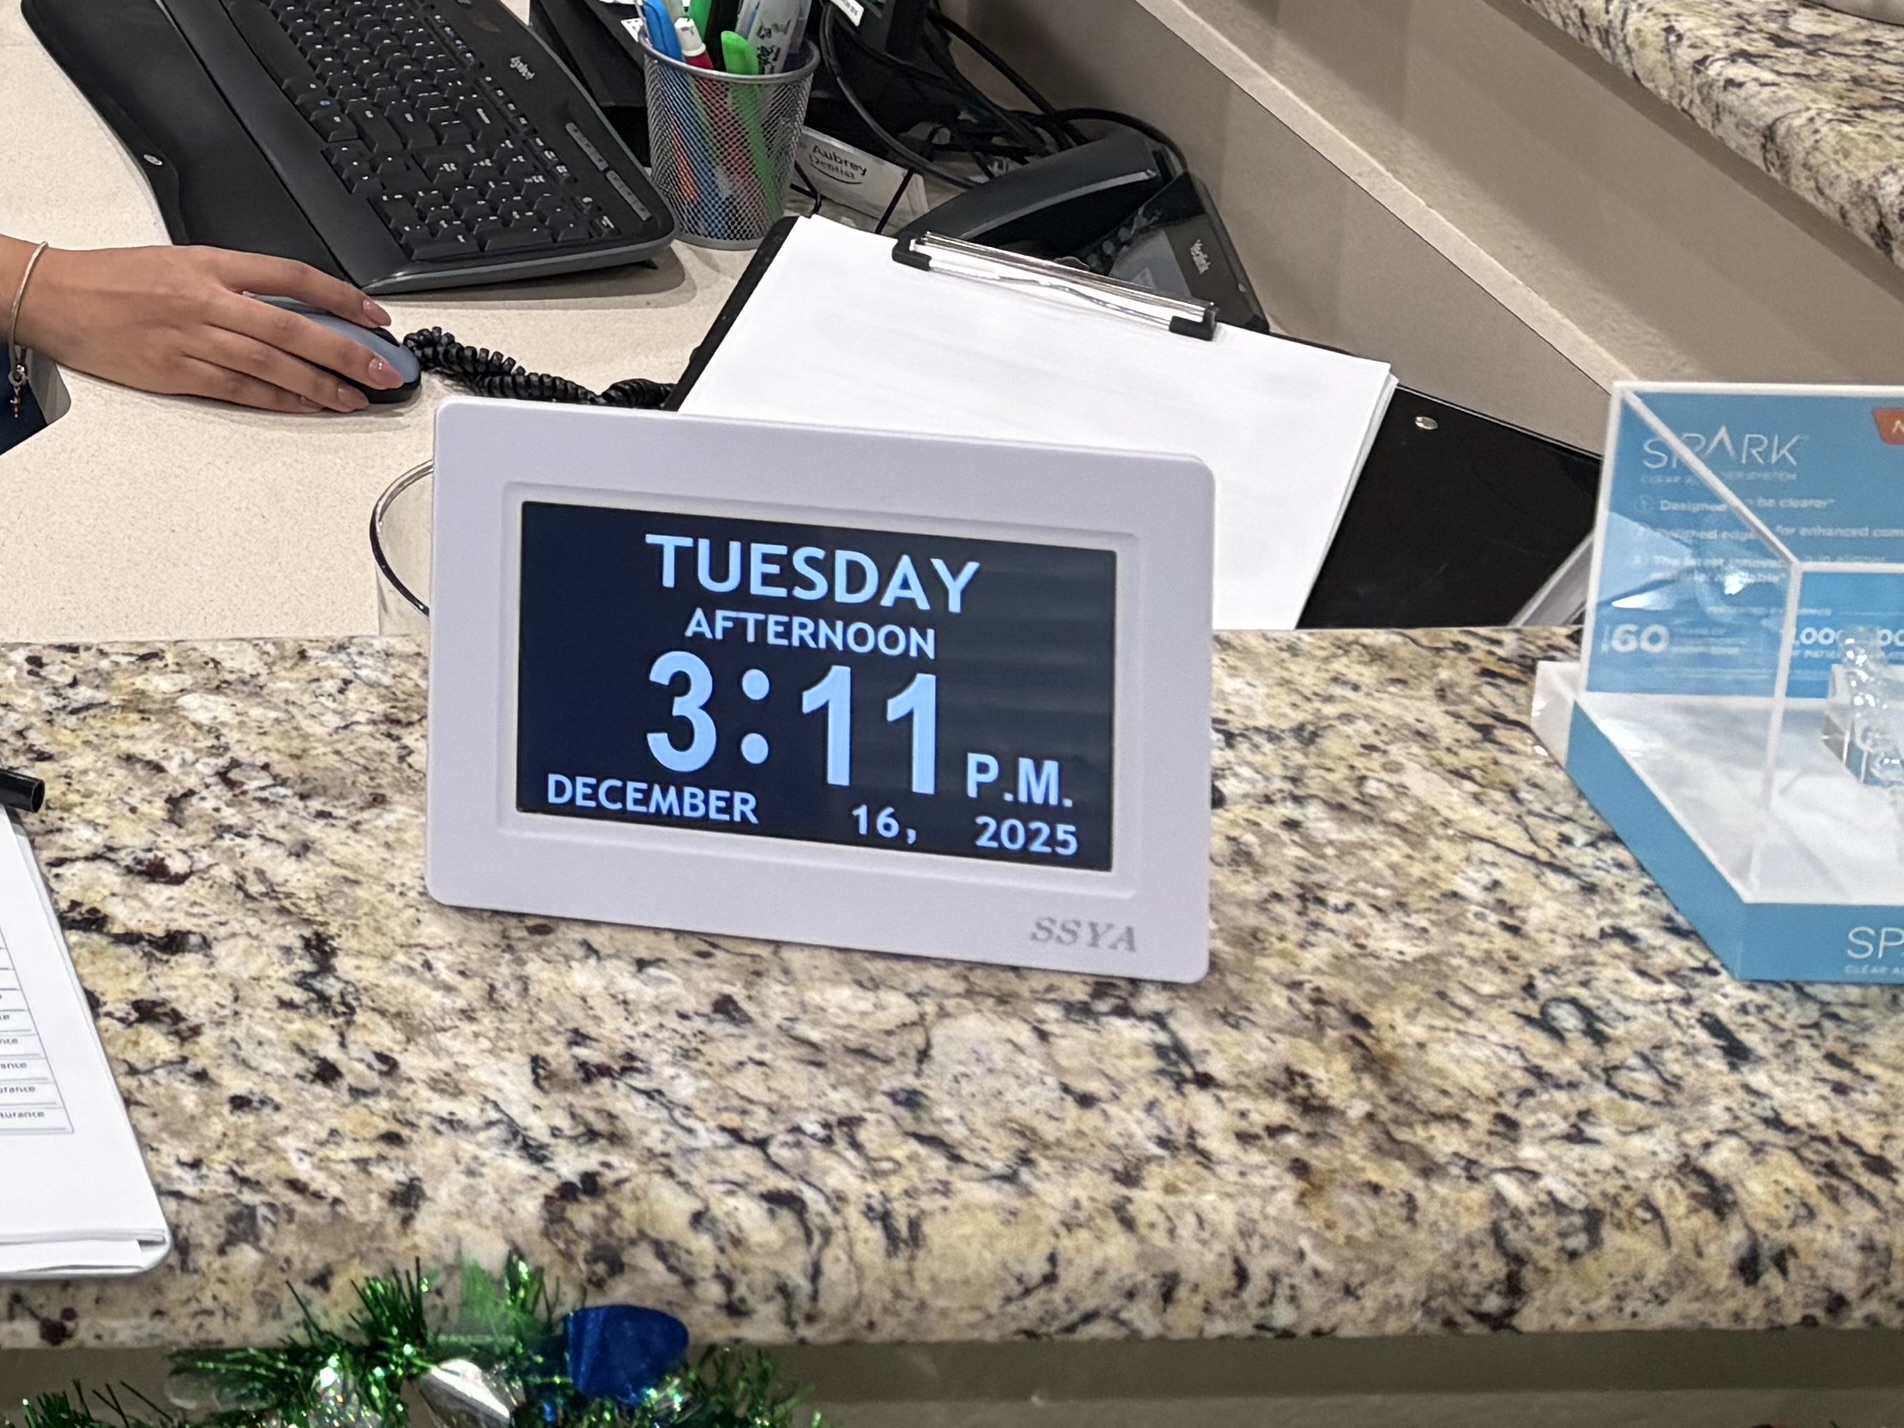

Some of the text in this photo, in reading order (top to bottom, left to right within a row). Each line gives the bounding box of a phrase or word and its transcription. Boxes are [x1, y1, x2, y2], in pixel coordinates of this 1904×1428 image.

[812, 145, 867, 176] Aubrey
[1643, 425, 1801, 470] SPARK
[1799, 526, 1870, 538] enhanced
[644, 533, 981, 613] TUESDAY
[684, 607, 937, 660] AFTERNOON
[646, 650, 1074, 808] 3:11 P.M.
[547, 773, 1079, 856] DECEMBER 16, 2025
[1029, 916, 1138, 952] SSYA
